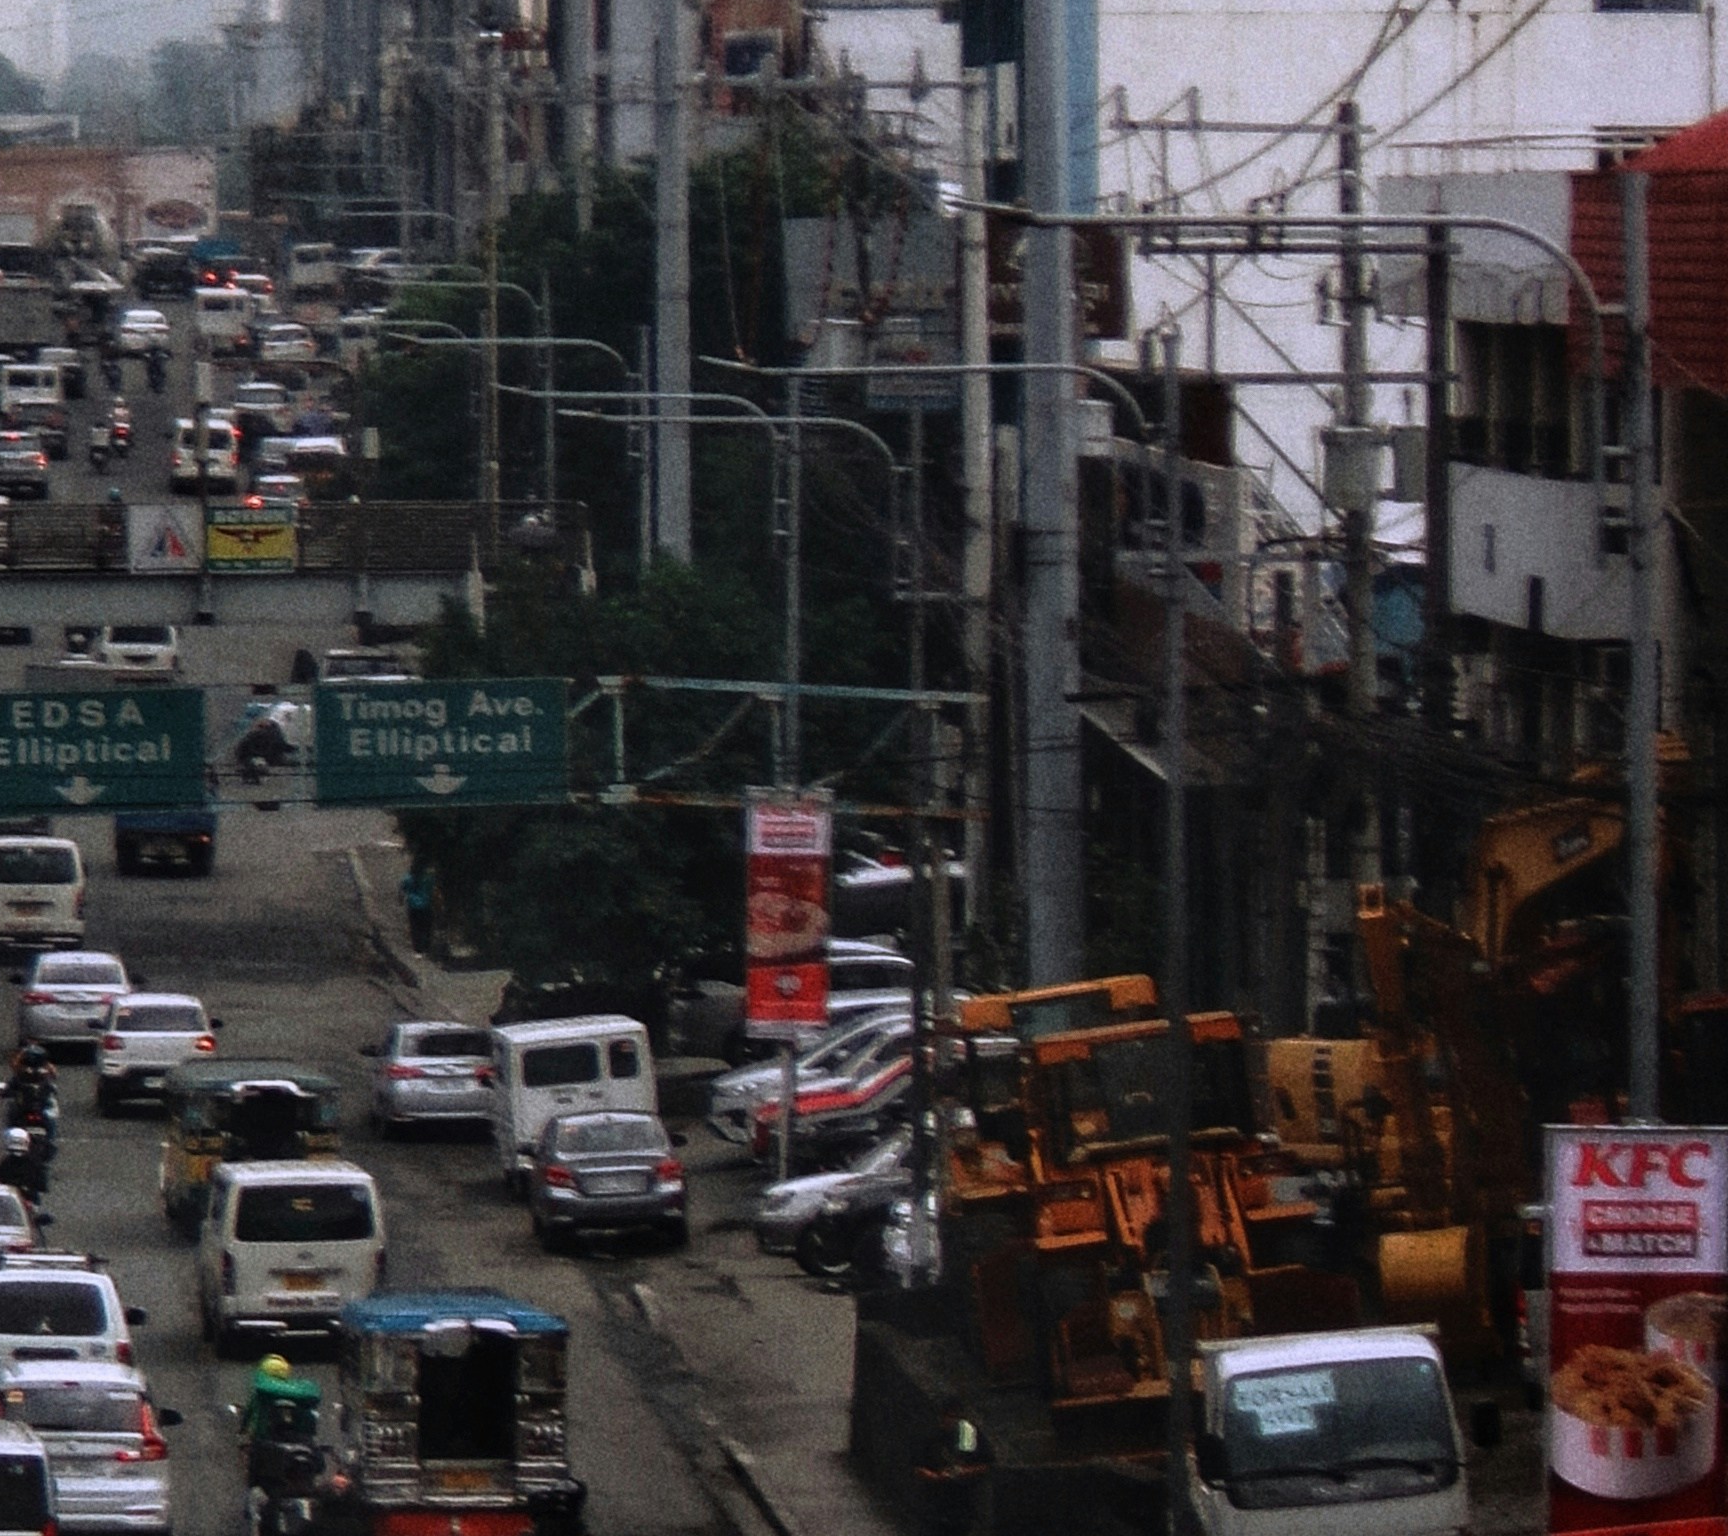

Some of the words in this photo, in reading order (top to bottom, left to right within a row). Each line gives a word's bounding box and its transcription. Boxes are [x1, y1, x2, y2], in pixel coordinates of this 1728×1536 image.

[11, 697, 145, 730] EDSA
[337, 691, 448, 727] Timog
[469, 690, 545, 716] Ave.
[348, 726, 533, 761] Elliptical
[1572, 1140, 1712, 1188] KFC
